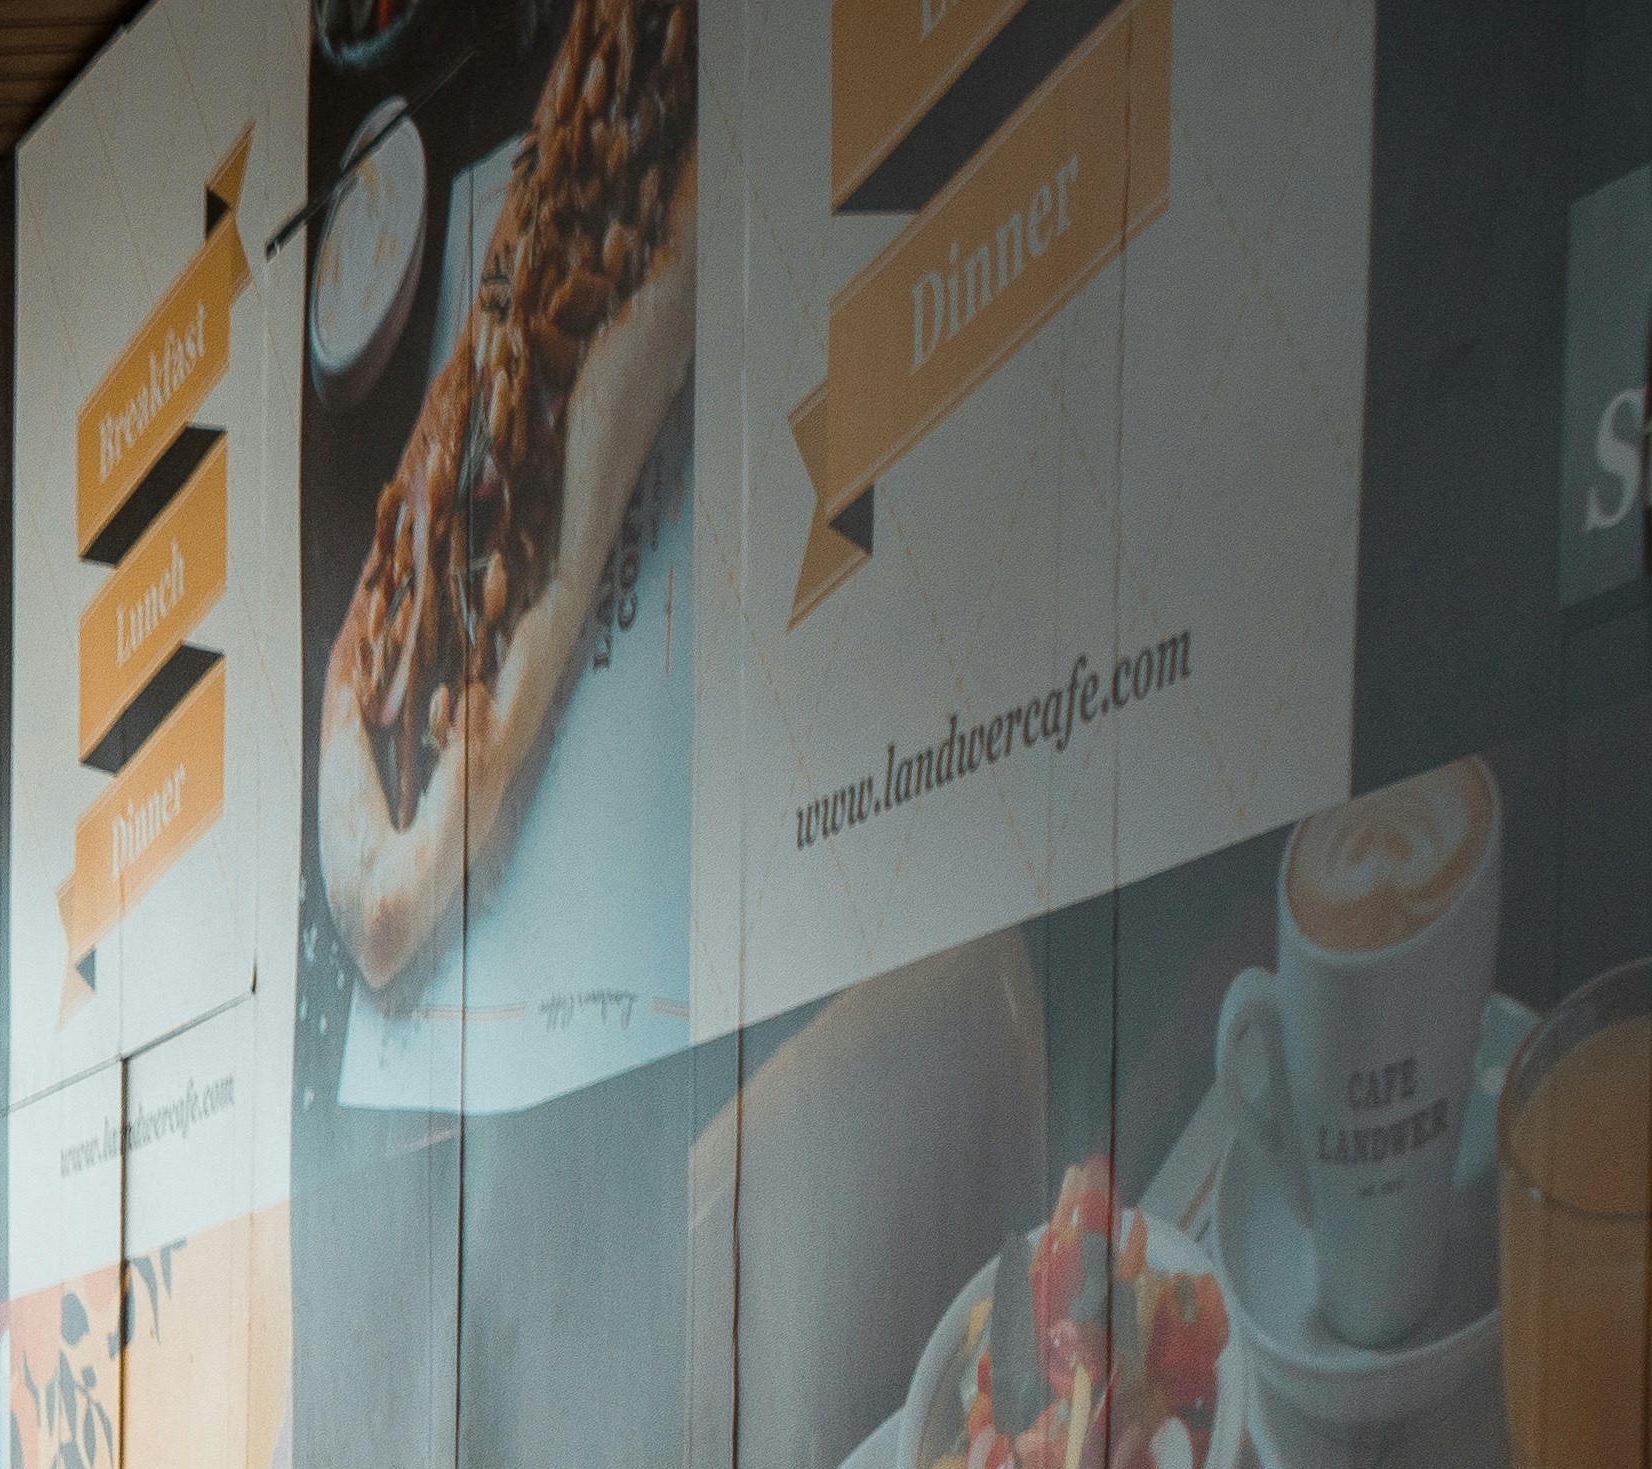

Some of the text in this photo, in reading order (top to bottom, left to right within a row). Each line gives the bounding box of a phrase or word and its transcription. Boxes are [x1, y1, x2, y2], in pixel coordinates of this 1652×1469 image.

[908, 153, 1080, 376] Dinner
[97, 303, 209, 481] Breakfast
[114, 543, 187, 667] Lunch
[793, 630, 1193, 851] www.landwercafe.com
[110, 764, 187, 877] Dinner
[1318, 1096, 1449, 1166] LANDWER
[1348, 1057, 1417, 1113] CAFE
